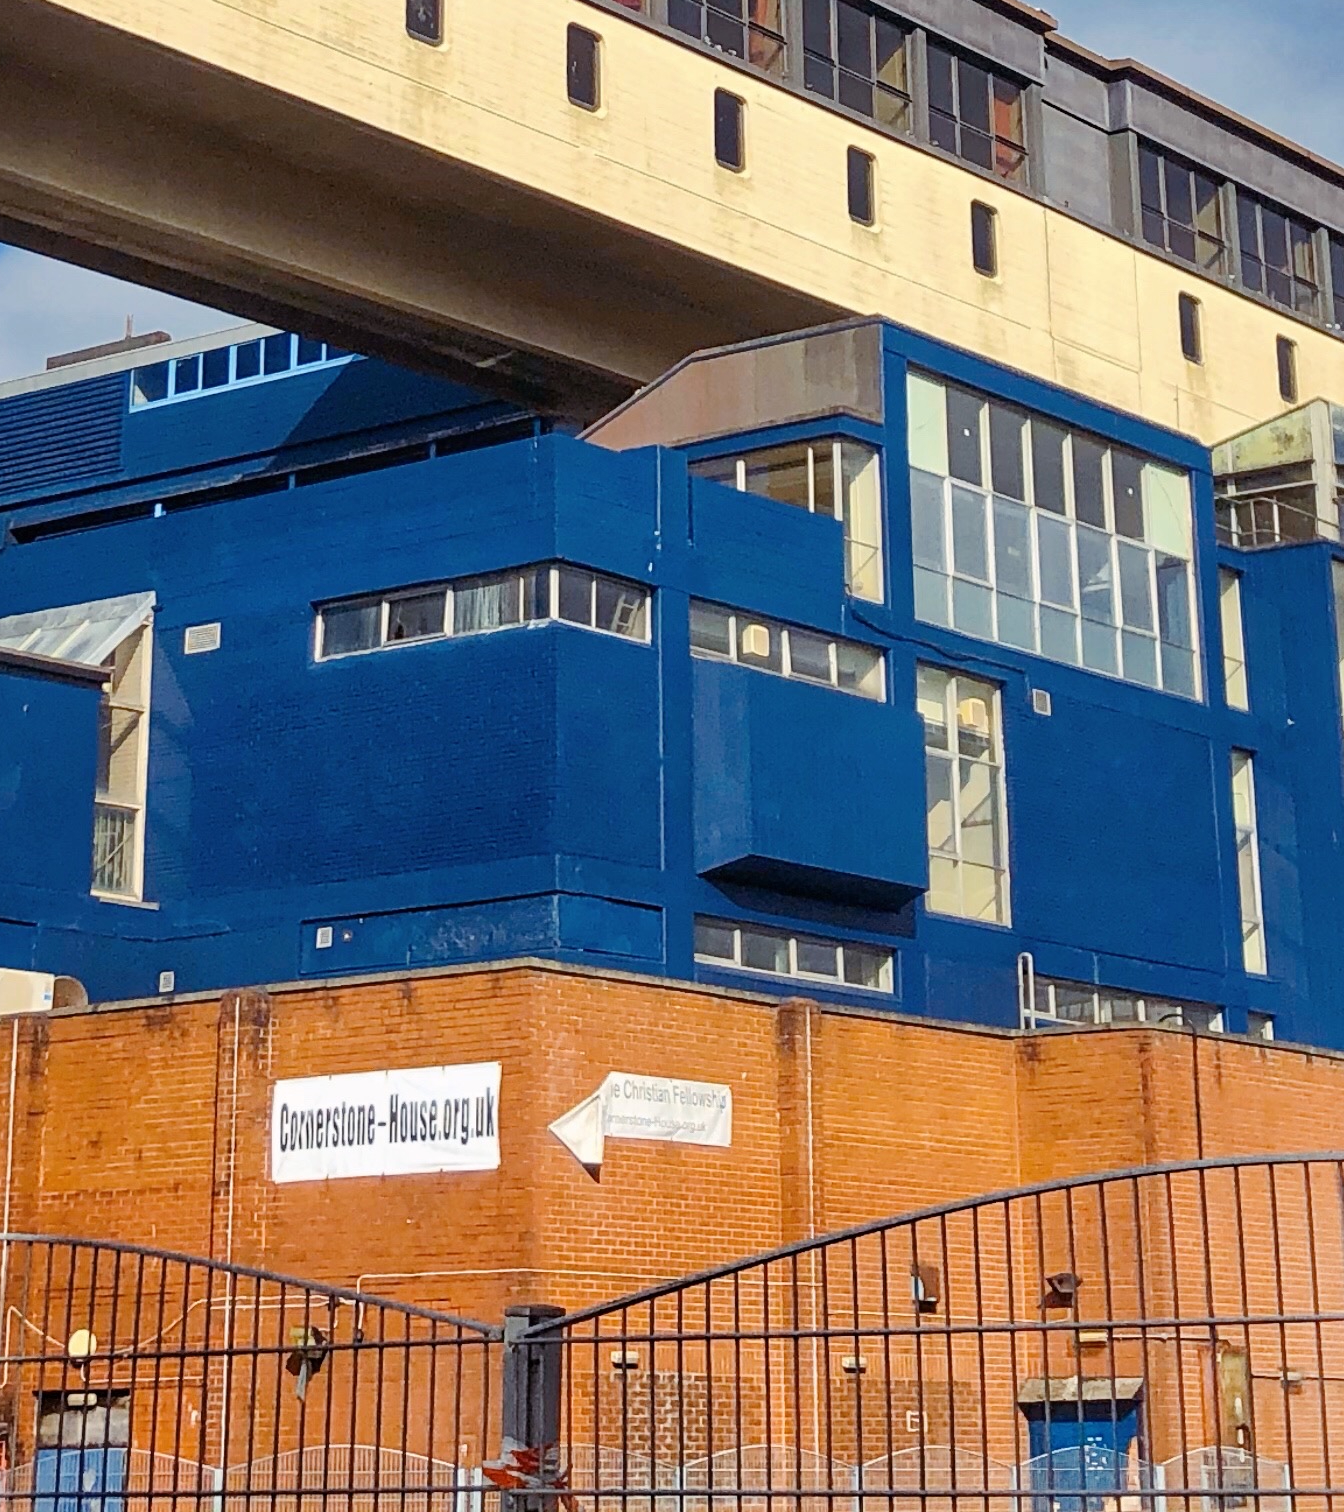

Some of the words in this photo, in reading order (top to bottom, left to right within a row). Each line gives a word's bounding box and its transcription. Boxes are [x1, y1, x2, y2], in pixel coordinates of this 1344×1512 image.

[623, 1079, 671, 1105] Christian
[672, 1085, 727, 1113] Fellowship
[280, 1087, 494, 1153] Cornerstone-House.org.uk
[607, 1114, 706, 1133] ornerstone-House.org.uk
